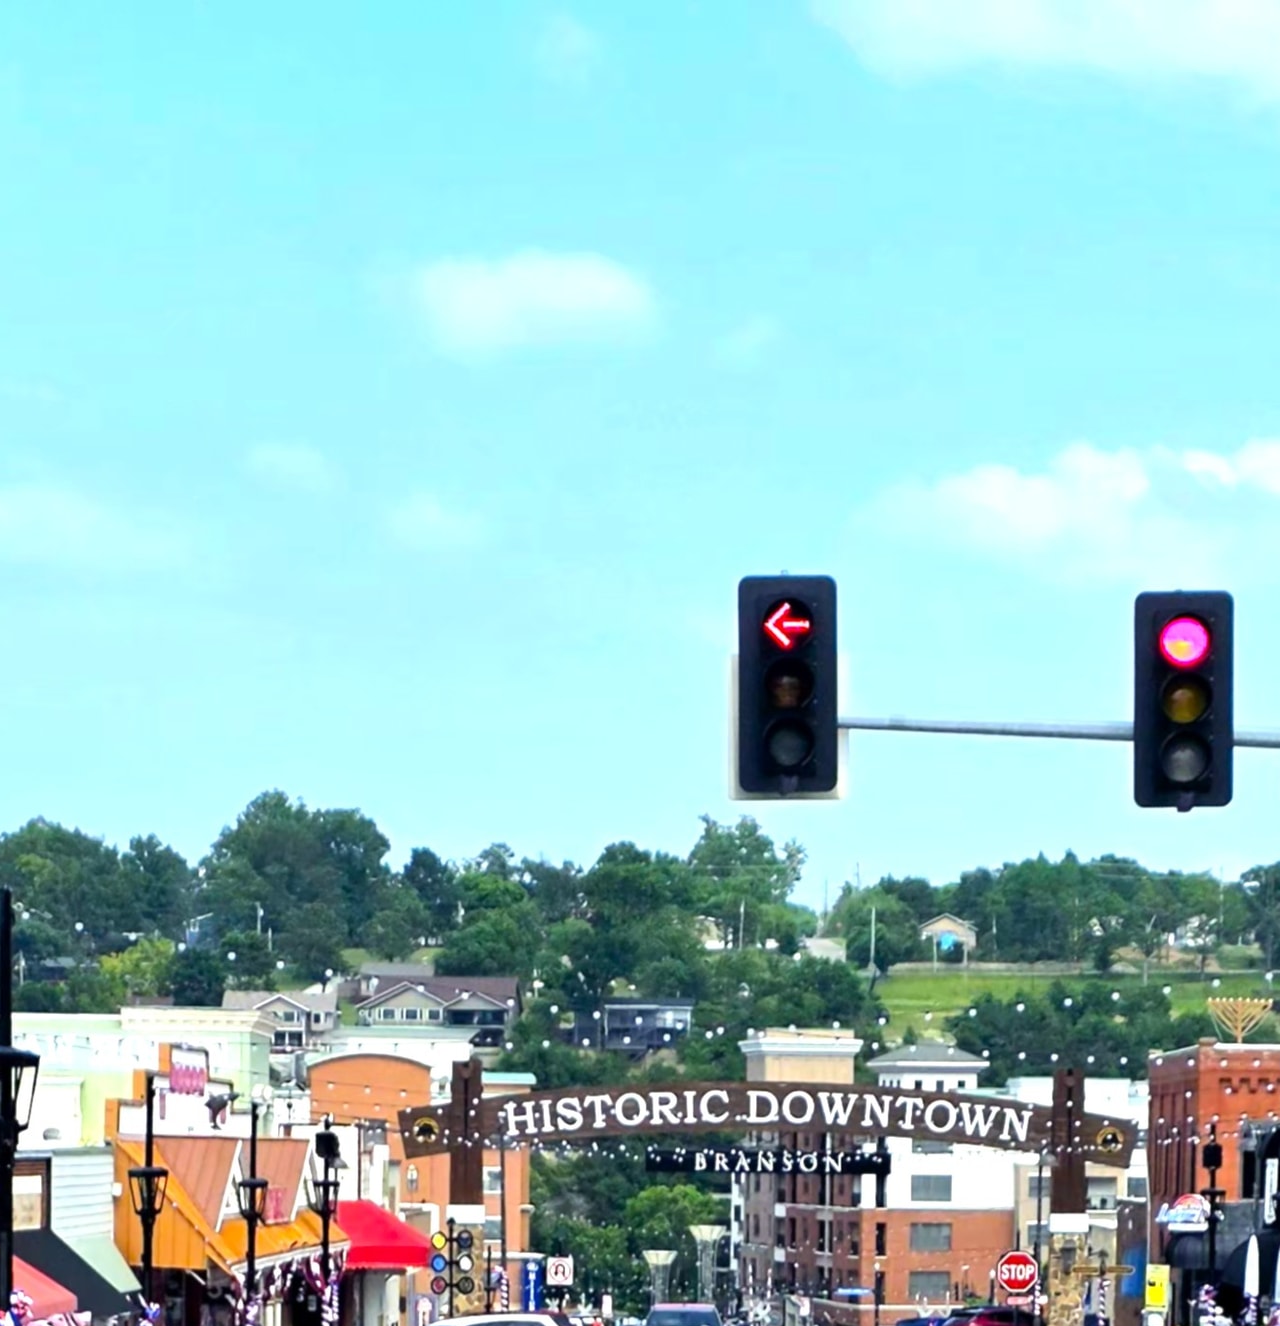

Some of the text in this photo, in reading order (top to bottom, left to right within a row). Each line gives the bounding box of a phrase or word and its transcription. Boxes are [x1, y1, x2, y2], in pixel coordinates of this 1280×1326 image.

[504, 1090, 1033, 1142] HISTORIC DOWNTOWN
[694, 1150, 844, 1174] BRANSON
[1001, 1262, 1035, 1282] STOP
